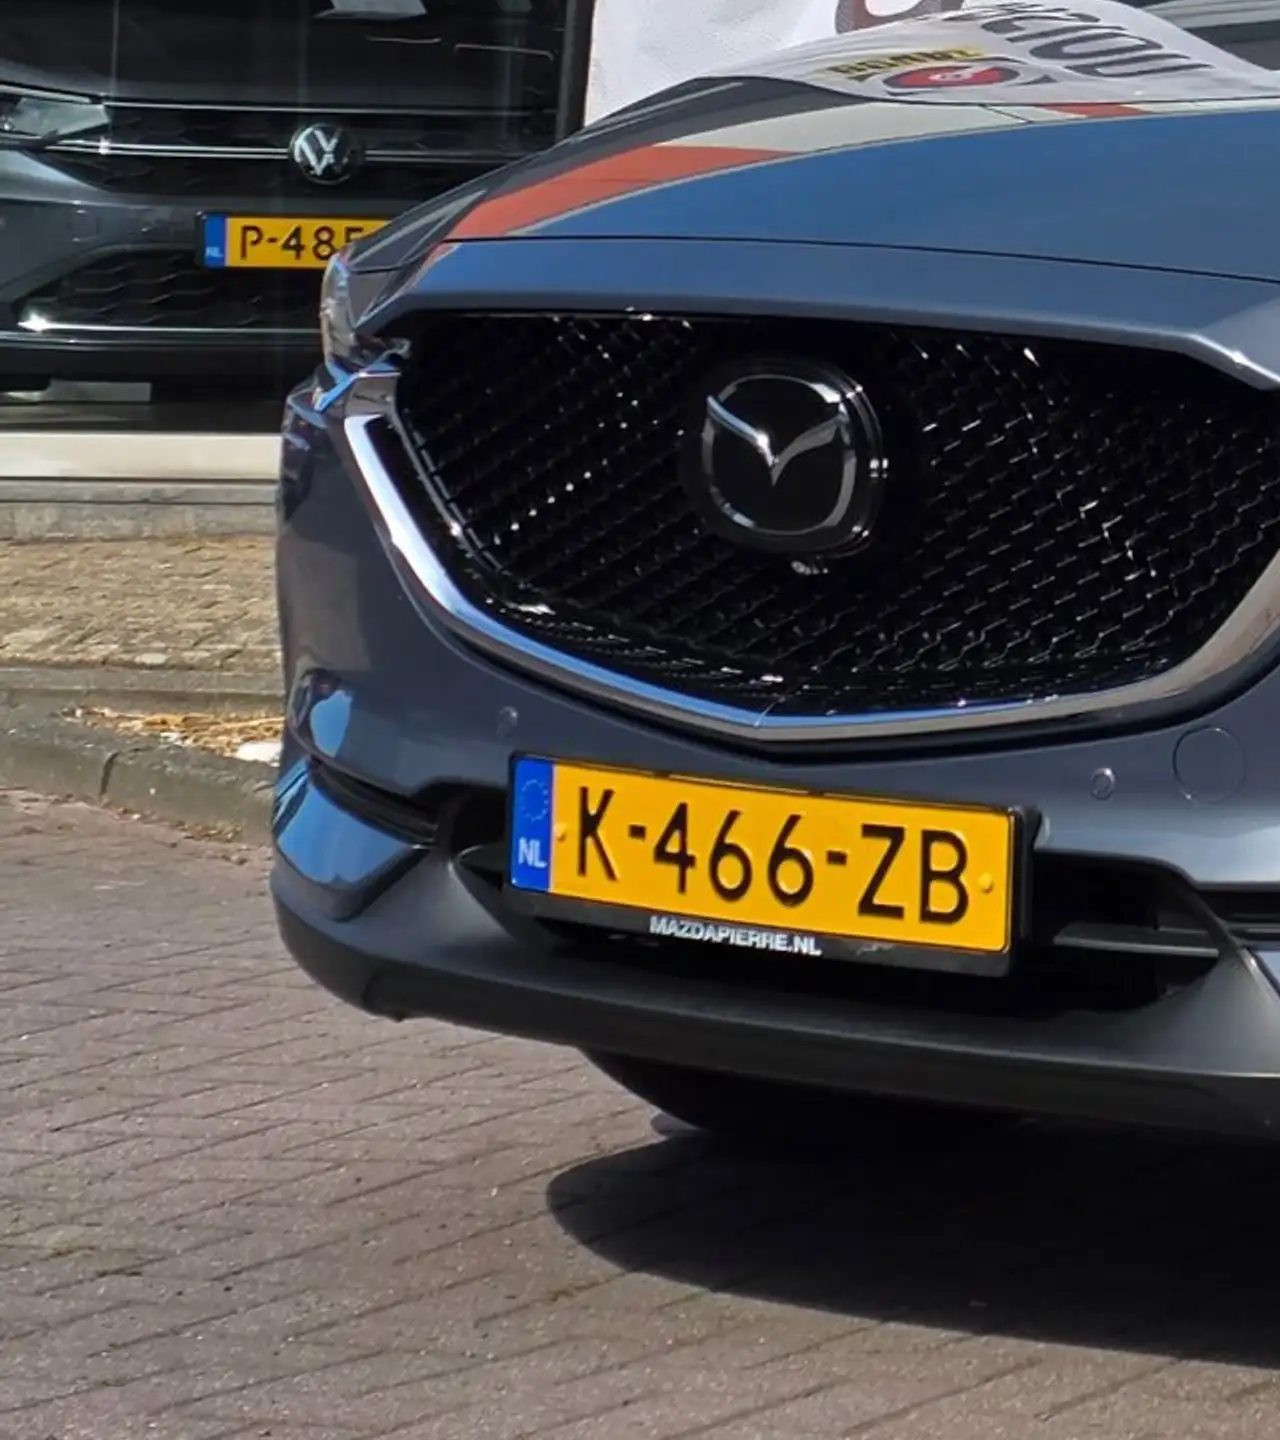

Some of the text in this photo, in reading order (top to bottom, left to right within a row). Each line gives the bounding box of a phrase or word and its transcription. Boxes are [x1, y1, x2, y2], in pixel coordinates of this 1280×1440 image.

[518, 836, 547, 869] NL
[576, 786, 970, 925] K-466-ZB
[650, 915, 823, 956] MAZDAPIERRE.NL
